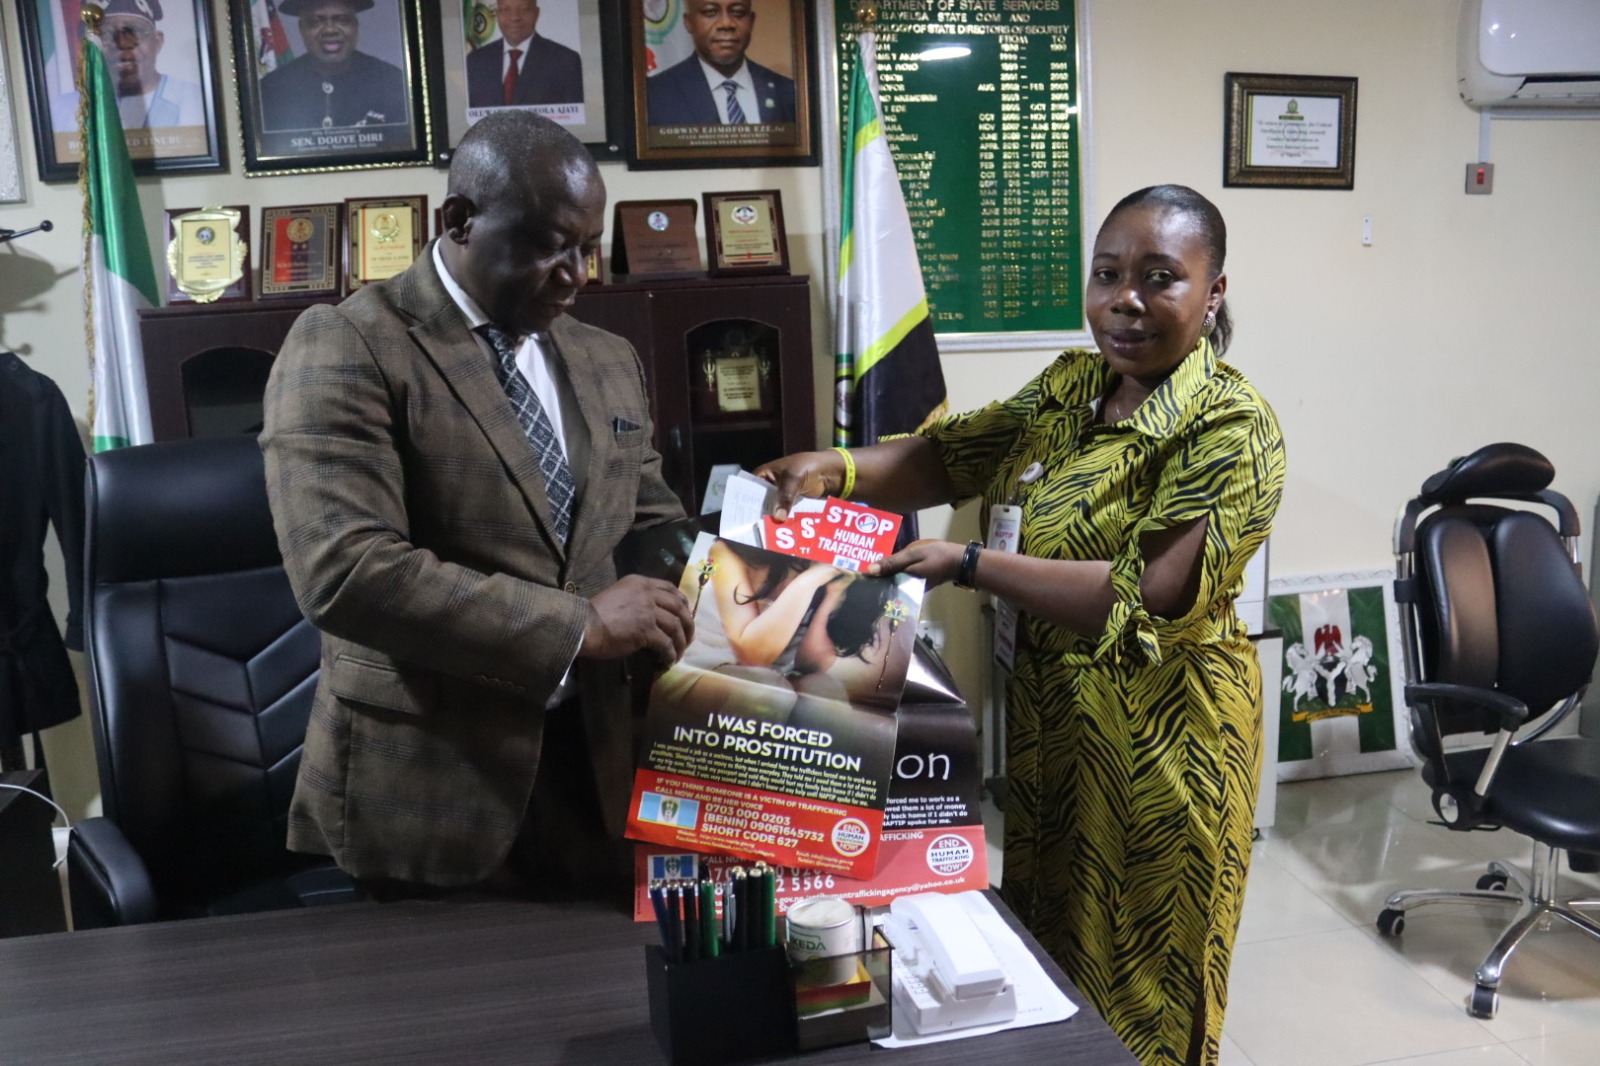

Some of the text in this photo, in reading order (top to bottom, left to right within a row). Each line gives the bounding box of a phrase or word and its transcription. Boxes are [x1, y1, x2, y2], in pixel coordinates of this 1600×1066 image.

[851, 0, 1059, 10] DARTMENT OF STATE SERVICES
[882, 12, 930, 21] BAYELSA
[938, 13, 968, 22] STATE
[913, 25, 928, 34] OF
[928, 25, 956, 34] STATE
[958, 25, 1010, 34] DIRECTORS
[1012, 26, 1024, 34] OF
[1026, 26, 1069, 34] SECURITY
[999, 35, 1028, 44] FROM
[557, 106, 579, 114] AJAYI
[979, 113, 995, 122] OCT
[660, 127, 698, 135] GODWIN
[703, 126, 752, 134] EJIMOFOR
[291, 133, 383, 148] SEN. DOUYE DIRI
[980, 132, 998, 140] JUNE
[980, 171, 996, 179] OCT
[826, 506, 894, 536] STOP
[834, 528, 876, 549] HUMAN
[818, 536, 884, 562] TRAFFICKING
[708, 713, 833, 748] I WAS FORCED
[674, 726, 862, 772] INTO PROSTITUTION
[654, 786, 672, 795] CALL
[674, 789, 693, 798] NOW
[694, 792, 710, 801] AND
[723, 797, 738, 806] HER
[740, 800, 763, 810] VOICE
[664, 778, 680, 787] YOU
[681, 781, 704, 791] THINK
[705, 786, 742, 798] SOMEONE
[759, 795, 784, 805] VICTIM
[798, 802, 847, 816] TRAFFICKING
[705, 803, 791, 826] 0703 000 0203
[704, 812, 748, 829] (BENIN)
[750, 820, 825, 842] 09061645732
[907, 819, 926, 827] spoke
[843, 824, 861, 834] END
[701, 823, 742, 838] SHORT
[742, 830, 776, 844] CODE
[777, 836, 798, 848] 627
[838, 832, 864, 841] HUMAN
[840, 842, 858, 852] NOW!
[938, 839, 960, 848] END
[931, 849, 968, 858] HUMAN
[932, 854, 970, 863] TRAFFICKING
[940, 862, 962, 872] NOW!
[792, 876, 834, 892] 5566
